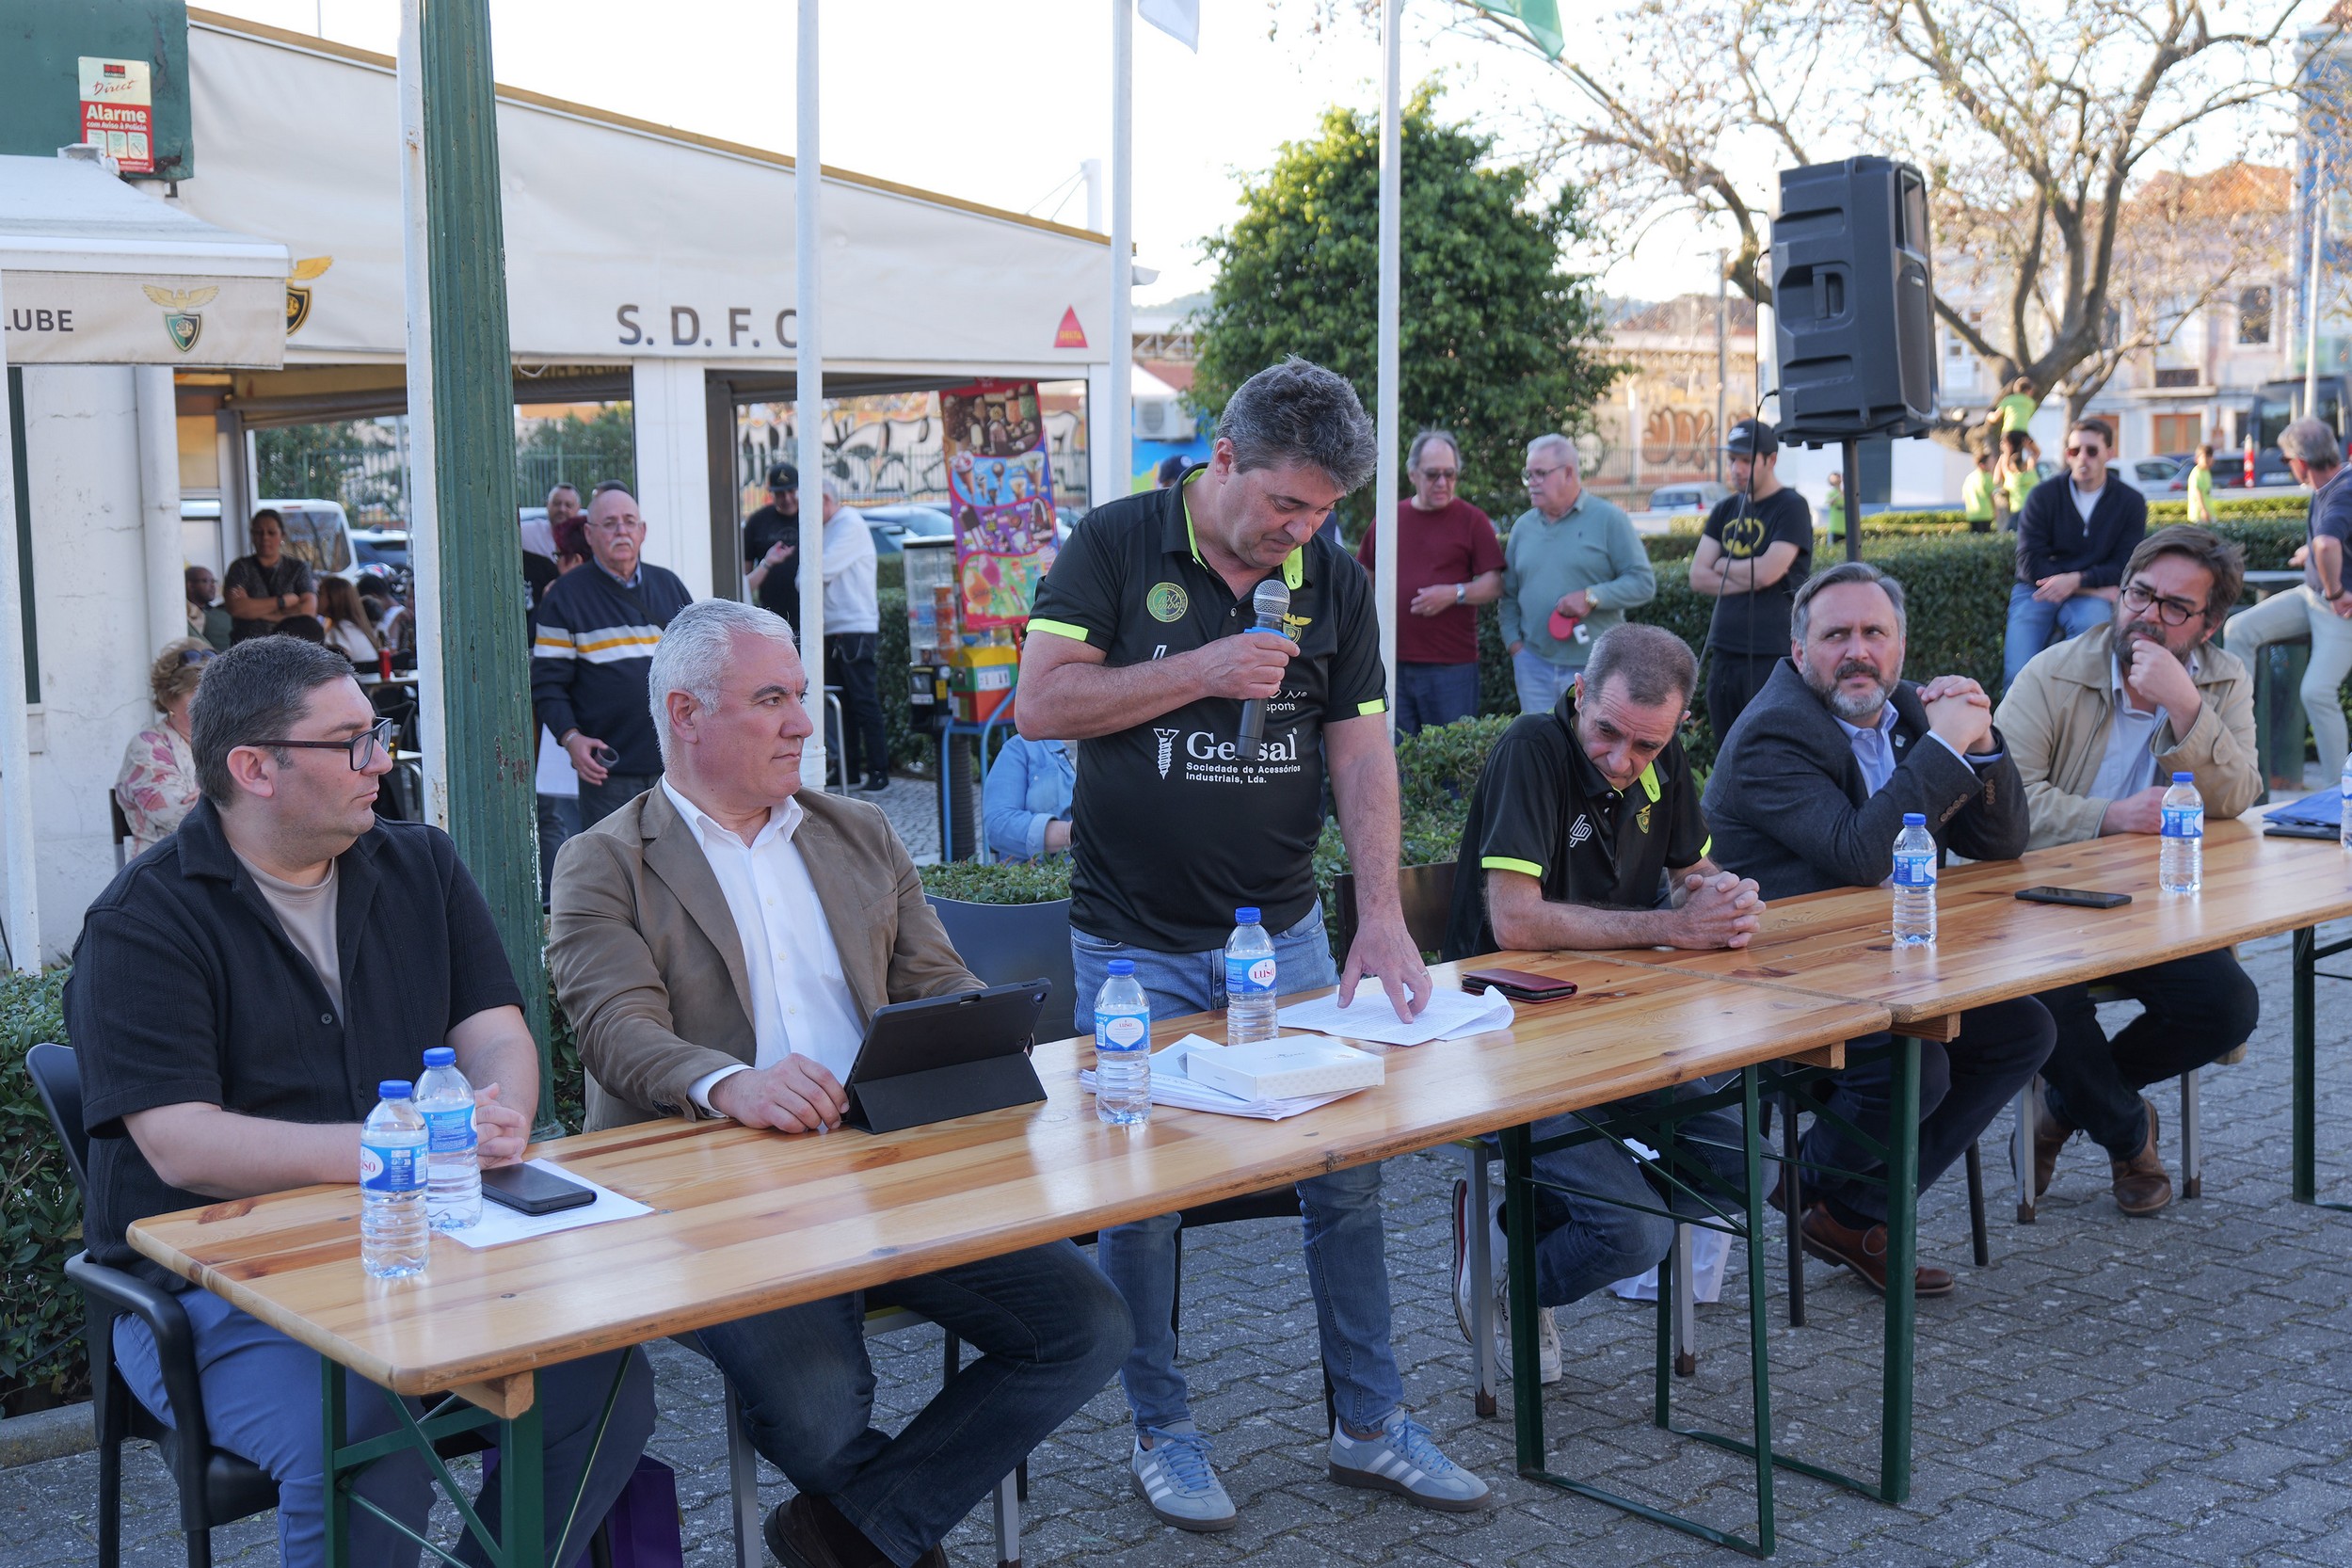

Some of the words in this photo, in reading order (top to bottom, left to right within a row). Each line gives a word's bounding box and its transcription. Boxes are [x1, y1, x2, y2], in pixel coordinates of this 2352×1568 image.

[93, 79, 136, 96] Direct
[87, 104, 147, 122] Alarme
[5, 309, 74, 332] UBE
[1186, 730, 1297, 761] Gesal
[1186, 762, 1239, 773] Sociedade
[1242, 765, 1254, 774] de
[1257, 764, 1301, 774] Acessórios
[1186, 772, 1243, 784] Industriais,
[1247, 776, 1267, 784] Lda.
[1254, 968, 1274, 979] LUSO
